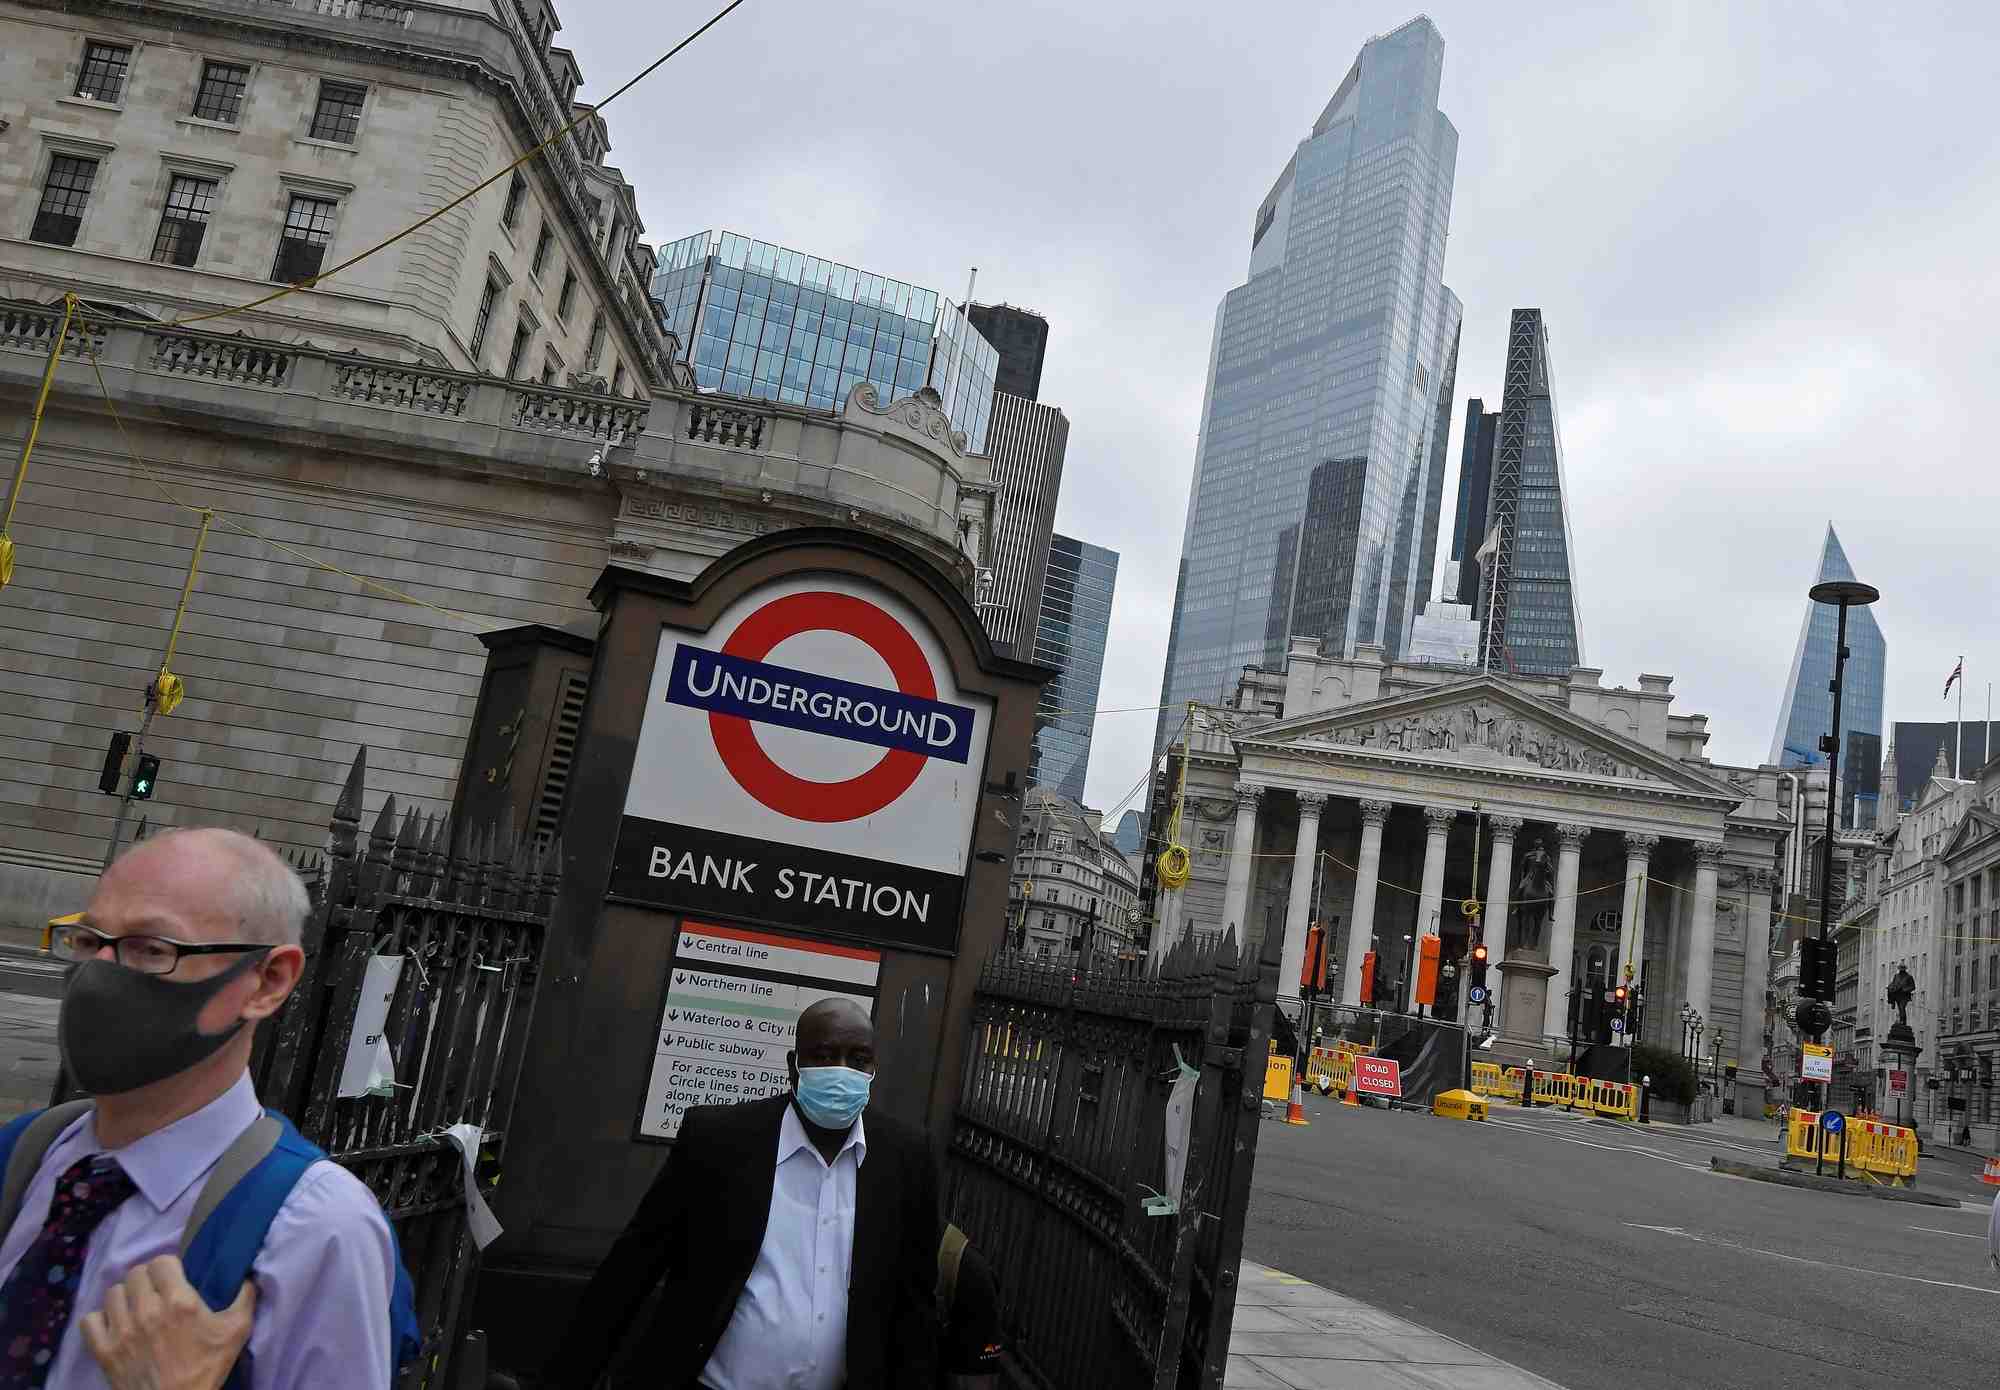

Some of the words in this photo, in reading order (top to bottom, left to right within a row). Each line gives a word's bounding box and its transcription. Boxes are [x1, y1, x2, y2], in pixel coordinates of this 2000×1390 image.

[687, 658, 957, 748] UNDERGROUND
[647, 846, 760, 894] BANK
[775, 868, 931, 922] STATION
[696, 939, 742, 956] Central
[746, 947, 769, 960] line
[689, 974, 747, 993] Northern
[751, 983, 773, 996] line
[682, 1010, 741, 1029] Waterloo
[745, 1019, 754, 1031] &
[758, 1021, 784, 1037] City
[787, 1025, 795, 1036] li
[365, 1033, 382, 1045] ENT
[676, 1035, 716, 1052] Public
[719, 1043, 765, 1060] subway
[672, 1060, 692, 1073] For
[695, 1064, 738, 1079] access
[742, 1069, 756, 1081] to
[1269, 1061, 1286, 1070] ion
[1365, 1063, 1389, 1074] ROAD
[668, 1074, 706, 1089] Circle
[709, 1080, 740, 1093] lines
[743, 1086, 766, 1097] and
[1361, 1076, 1394, 1089] CLOSED
[665, 1089, 700, 1105] along
[663, 1102, 684, 1116] Mo
